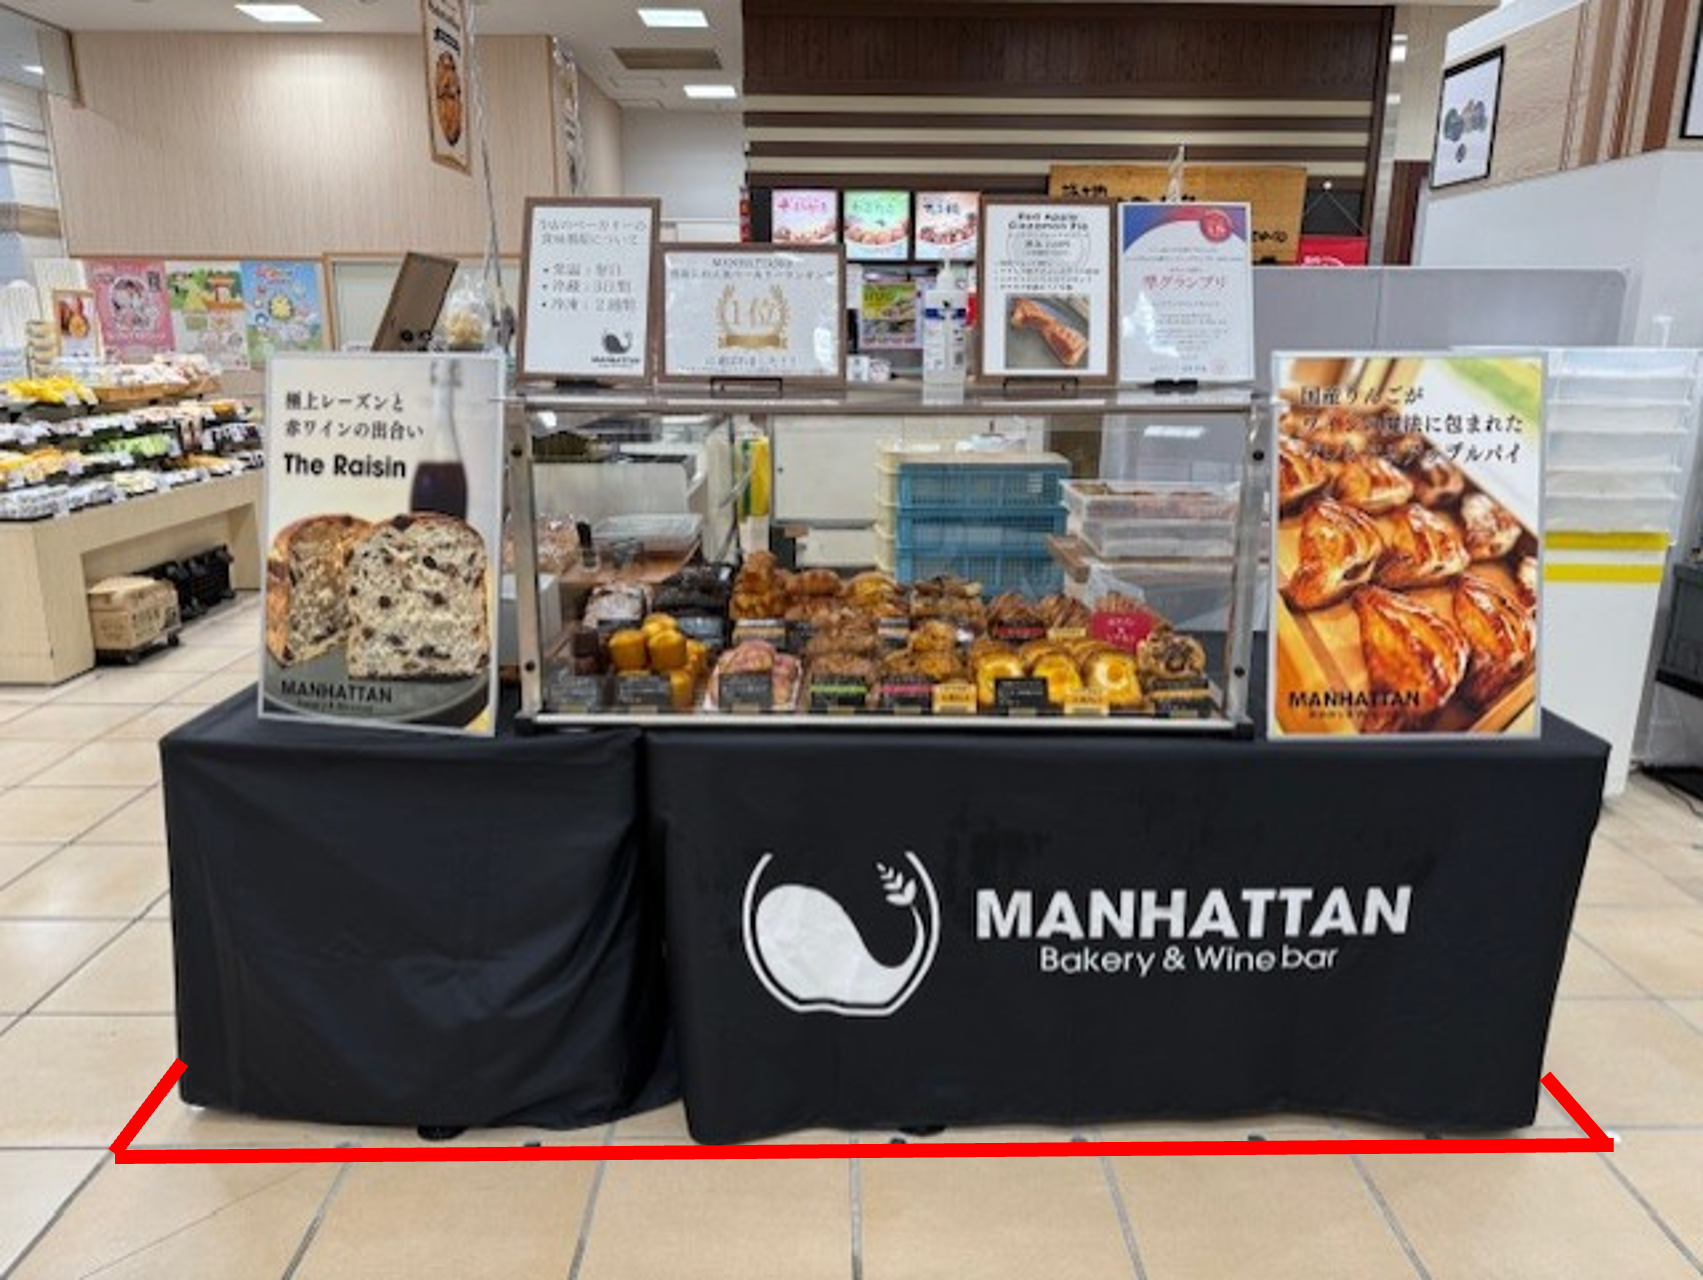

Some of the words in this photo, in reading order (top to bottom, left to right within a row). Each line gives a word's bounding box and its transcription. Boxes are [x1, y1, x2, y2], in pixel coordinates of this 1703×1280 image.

[285, 391, 404, 413] 極上レーズンと
[1301, 385, 1425, 405] 国産りんごが
[285, 418, 425, 441] 赤ワインの出合い
[284, 452, 325, 475] The
[333, 453, 406, 478] Raisin
[281, 680, 393, 703] MANHATTAN
[1288, 690, 1420, 708] MANHATTAN
[976, 885, 1413, 940] MANHATTAN
[1039, 945, 1156, 979] Bakery
[1162, 945, 1186, 971] &
